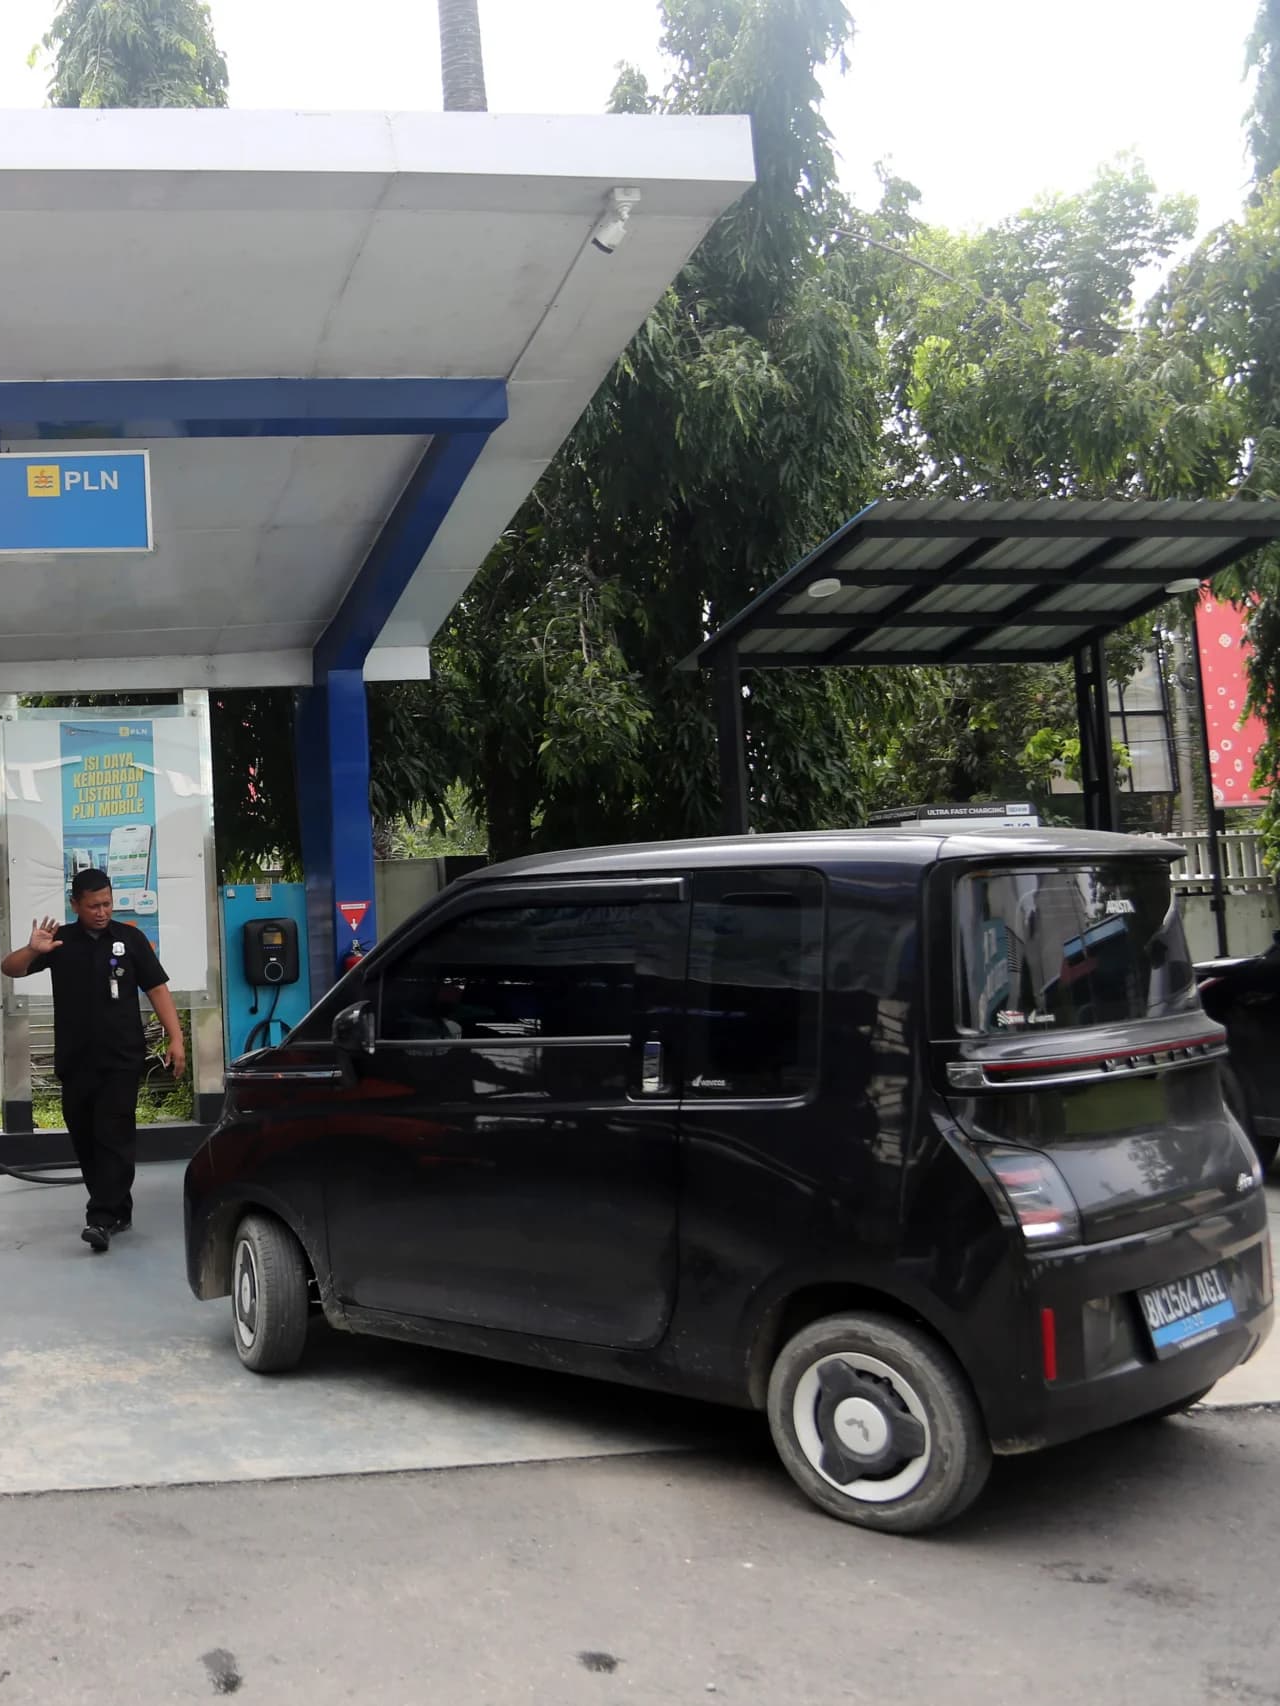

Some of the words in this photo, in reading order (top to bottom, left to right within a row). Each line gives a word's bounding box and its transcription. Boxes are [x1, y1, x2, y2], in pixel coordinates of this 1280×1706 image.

[64, 470, 119, 491] PLN
[130, 728, 148, 736] PLN
[84, 755, 99, 771] ISI
[104, 752, 133, 769] DAYA
[73, 767, 144, 788] KENDARAAN
[79, 784, 122, 803] LISTRIK
[126, 782, 138, 799] DI
[71, 803, 95, 820] PLN
[99, 797, 144, 817] MOBILE
[927, 809, 950, 817] ULTRA
[950, 808, 968, 816] FAST
[969, 807, 1005, 815] CHARGING
